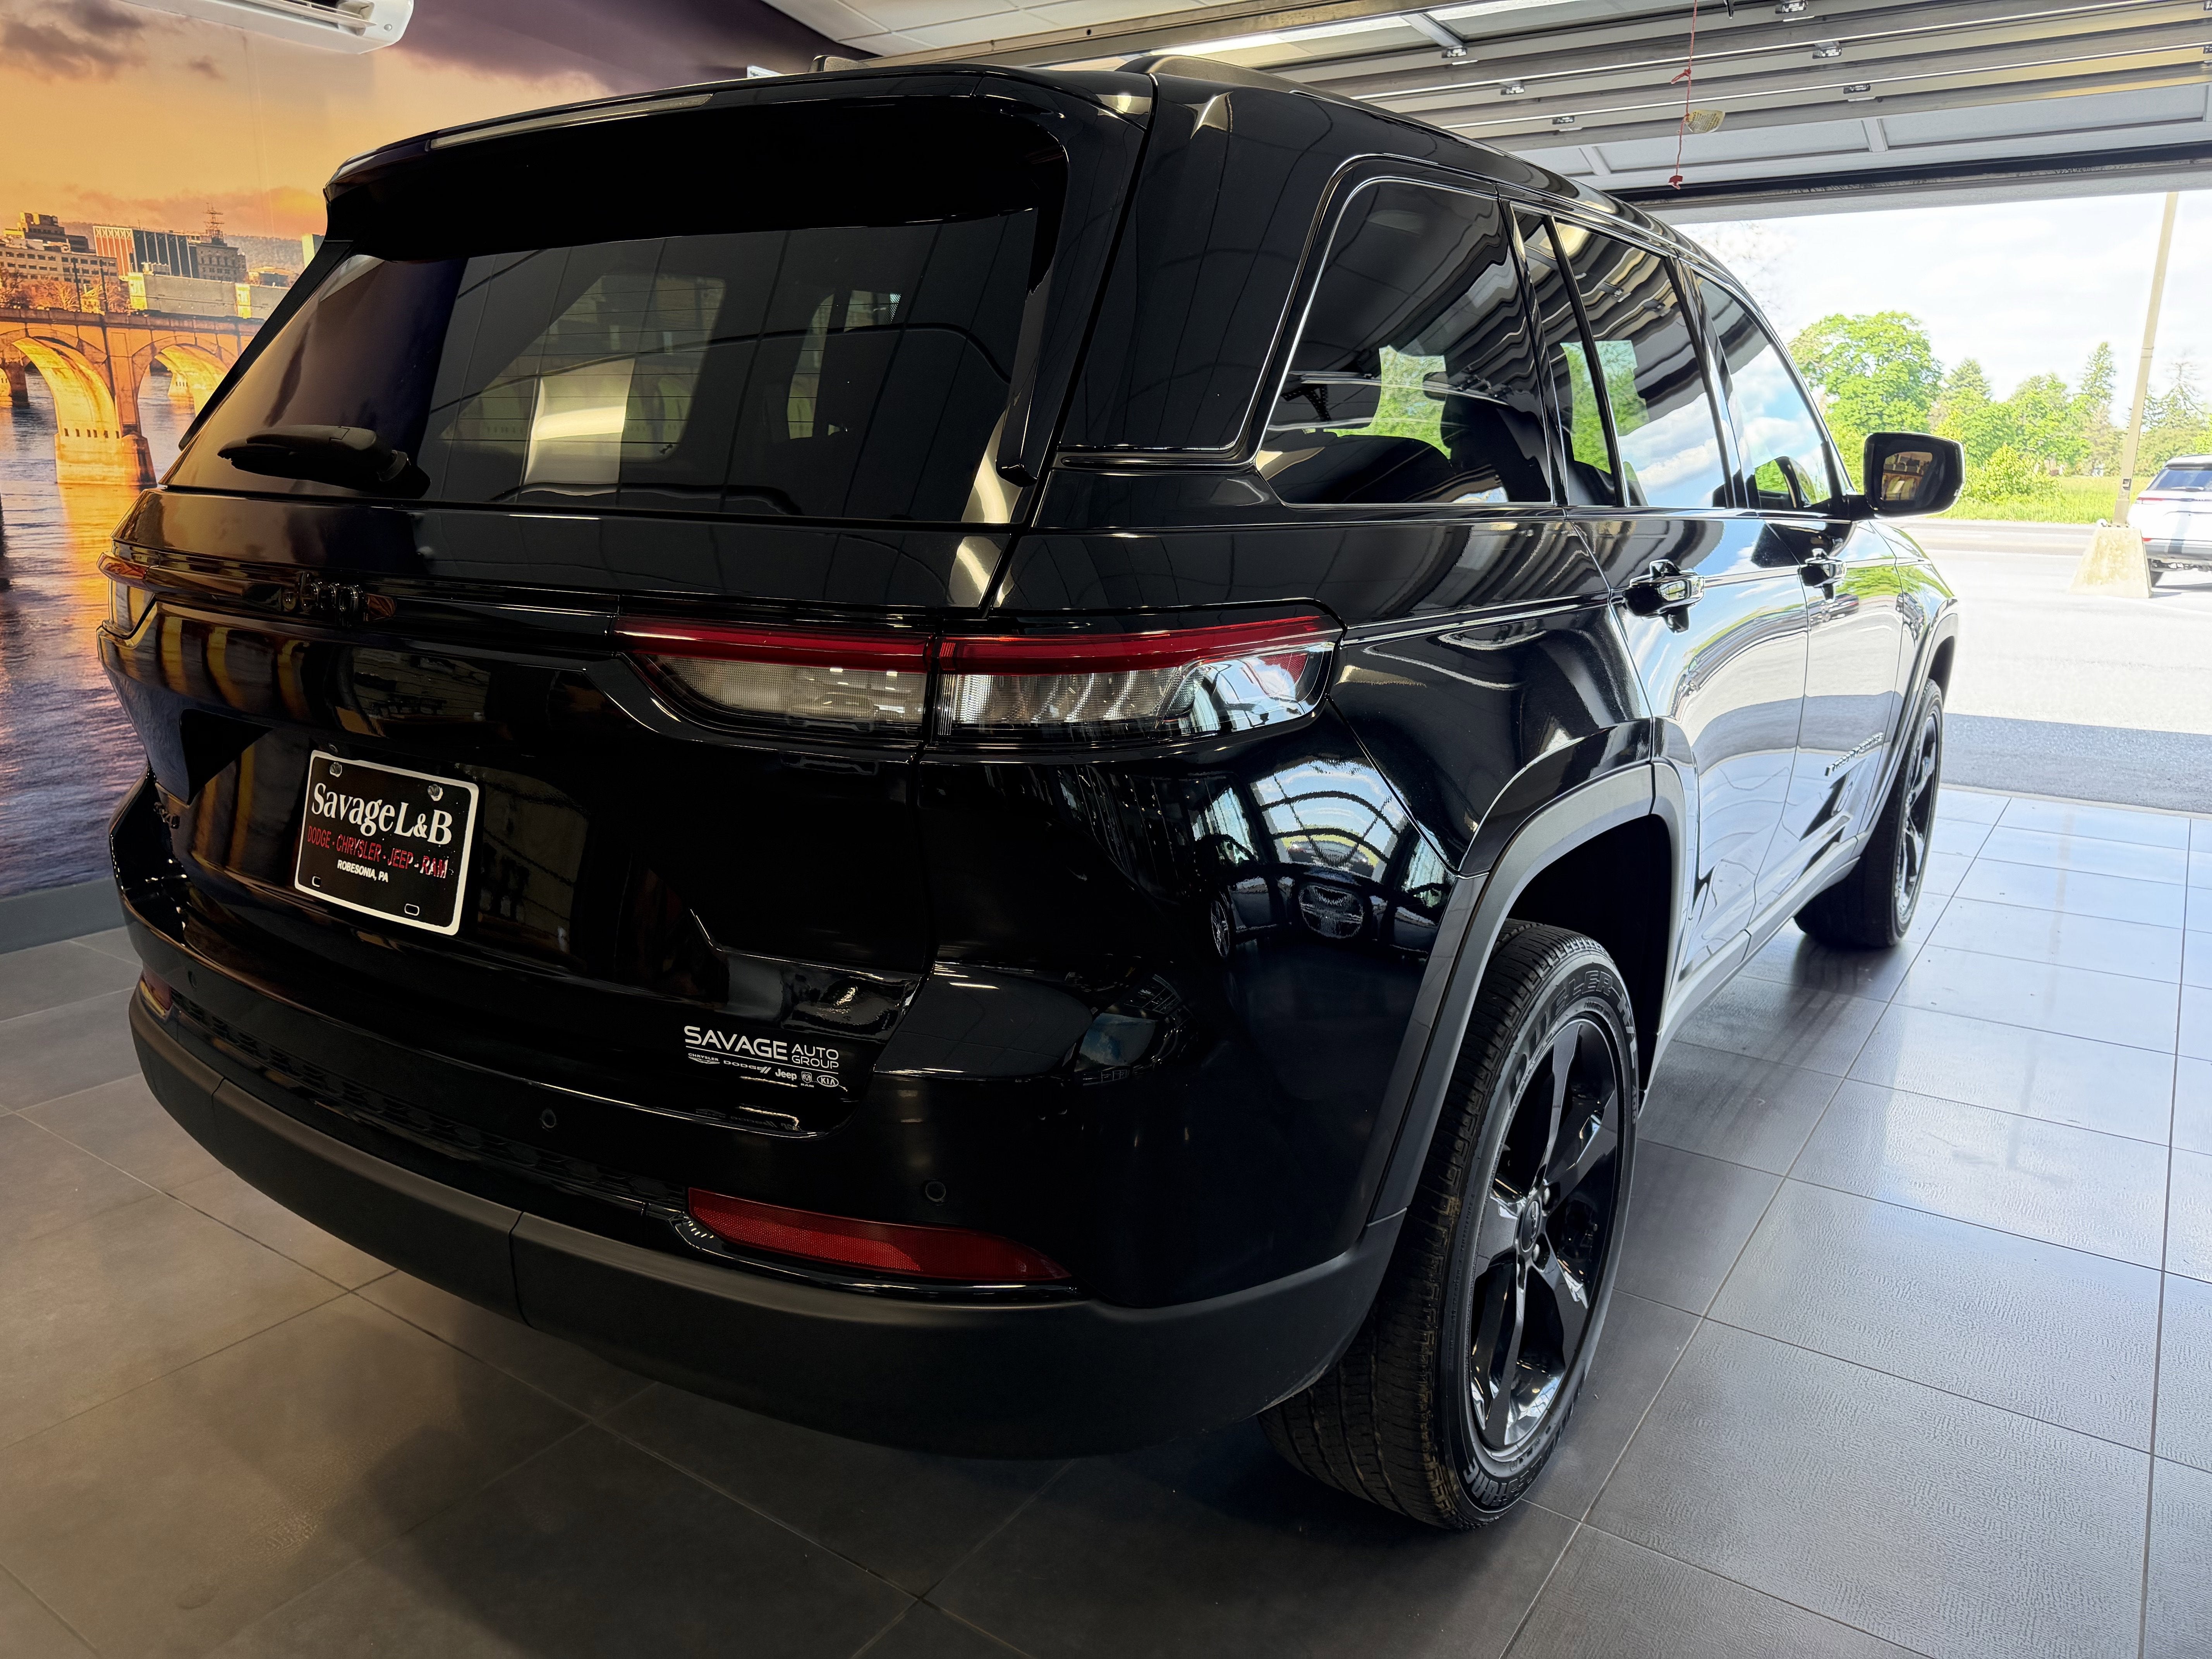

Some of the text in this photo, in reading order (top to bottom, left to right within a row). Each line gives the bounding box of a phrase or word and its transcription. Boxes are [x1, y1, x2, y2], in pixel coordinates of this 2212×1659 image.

[307, 826, 448, 878] DODGE CHRYSLER JEEP RAM
[337, 859, 388, 883] ROBESONIA, PA
[684, 1025, 839, 1061] SAVAGE AUTO
[688, 1053, 719, 1061] CHRYSLER
[775, 1069, 797, 1080] Jeep
[821, 1077, 835, 1085] KIA
[792, 1055, 839, 1069] GROUP
